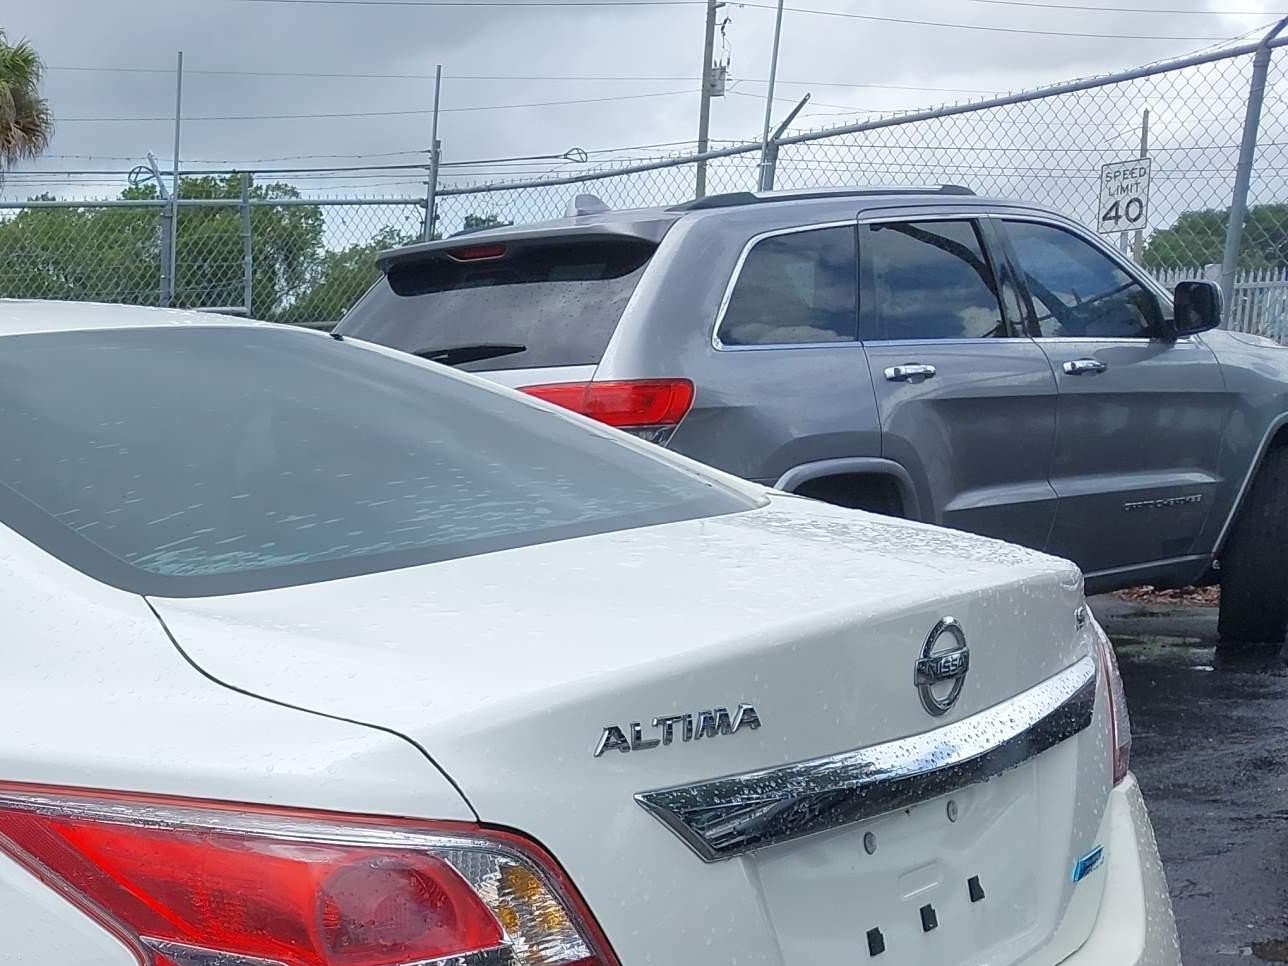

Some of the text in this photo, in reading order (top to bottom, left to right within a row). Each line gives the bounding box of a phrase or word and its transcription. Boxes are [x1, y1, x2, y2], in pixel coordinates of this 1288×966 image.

[1105, 167, 1147, 182] SPEED
[1108, 181, 1141, 196] LIMIT
[1102, 197, 1143, 225] 40
[594, 703, 762, 757] ALTIMA
